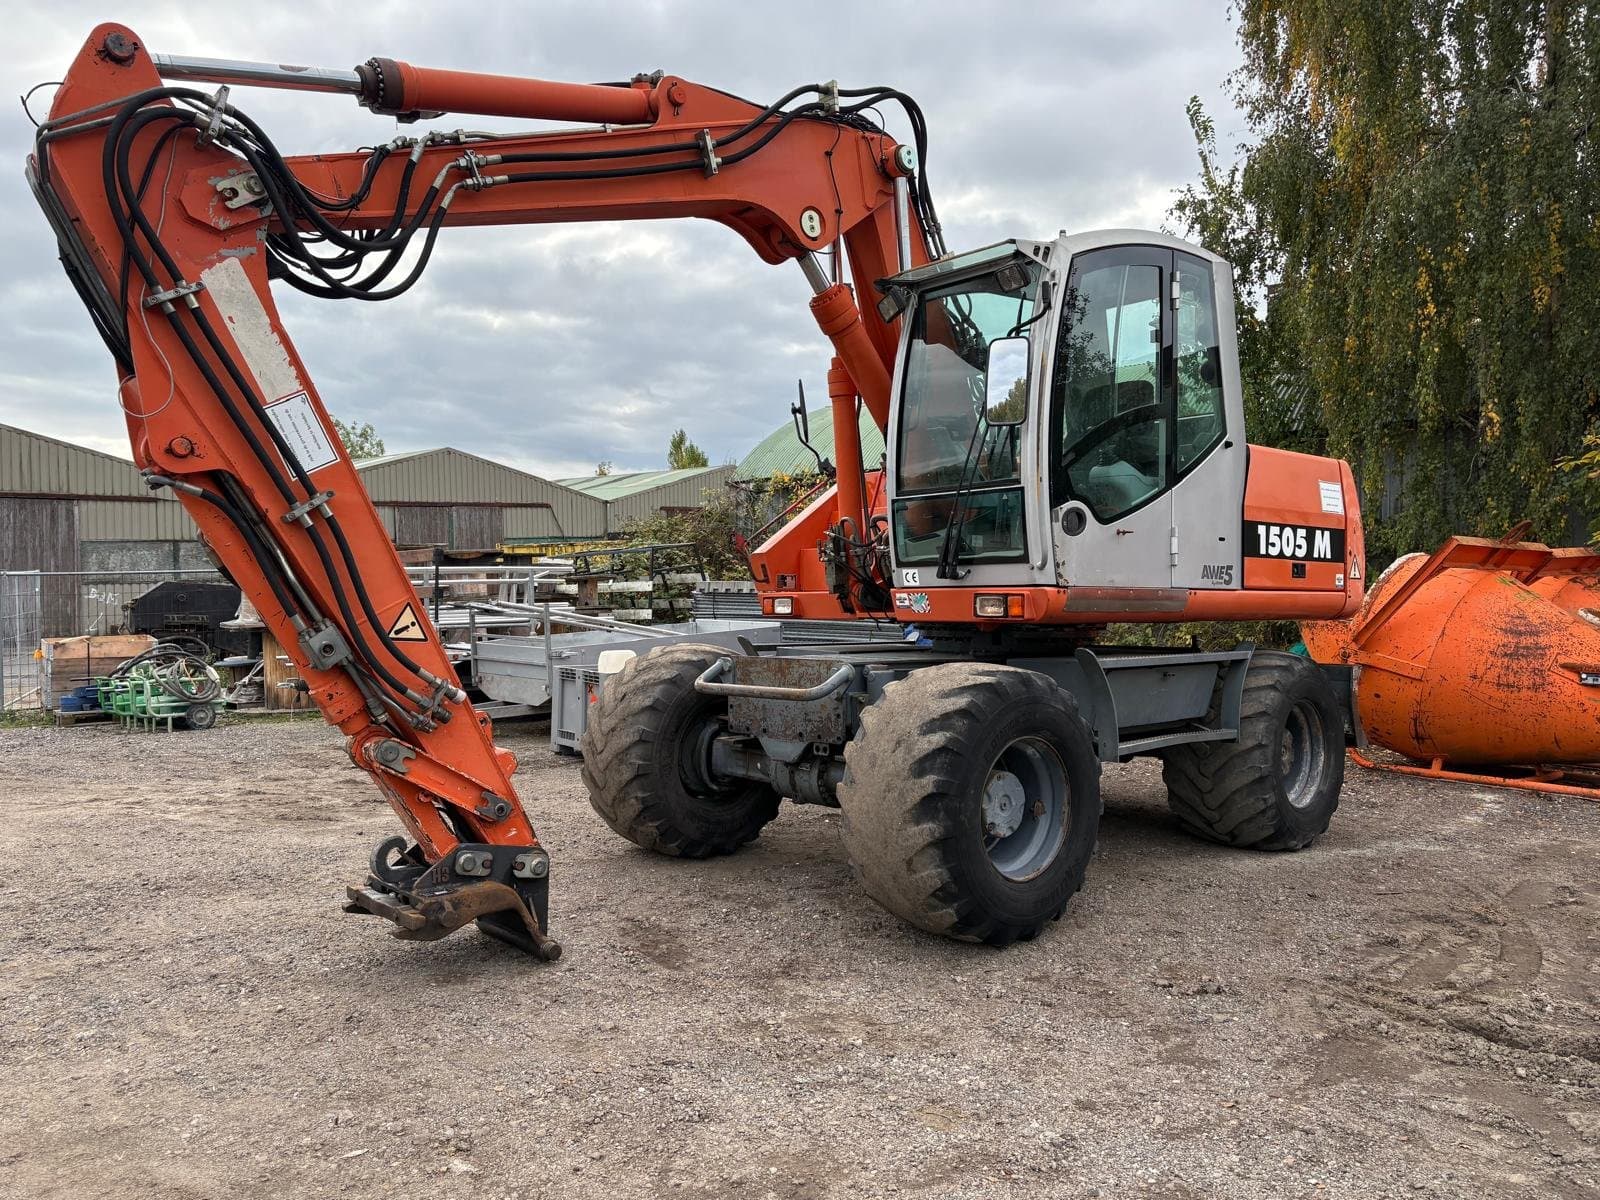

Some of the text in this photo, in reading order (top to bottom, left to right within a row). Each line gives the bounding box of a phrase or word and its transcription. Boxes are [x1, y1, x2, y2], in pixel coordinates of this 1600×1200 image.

[1257, 525, 1332, 559] 1505 M
[905, 572, 918, 583] CE
